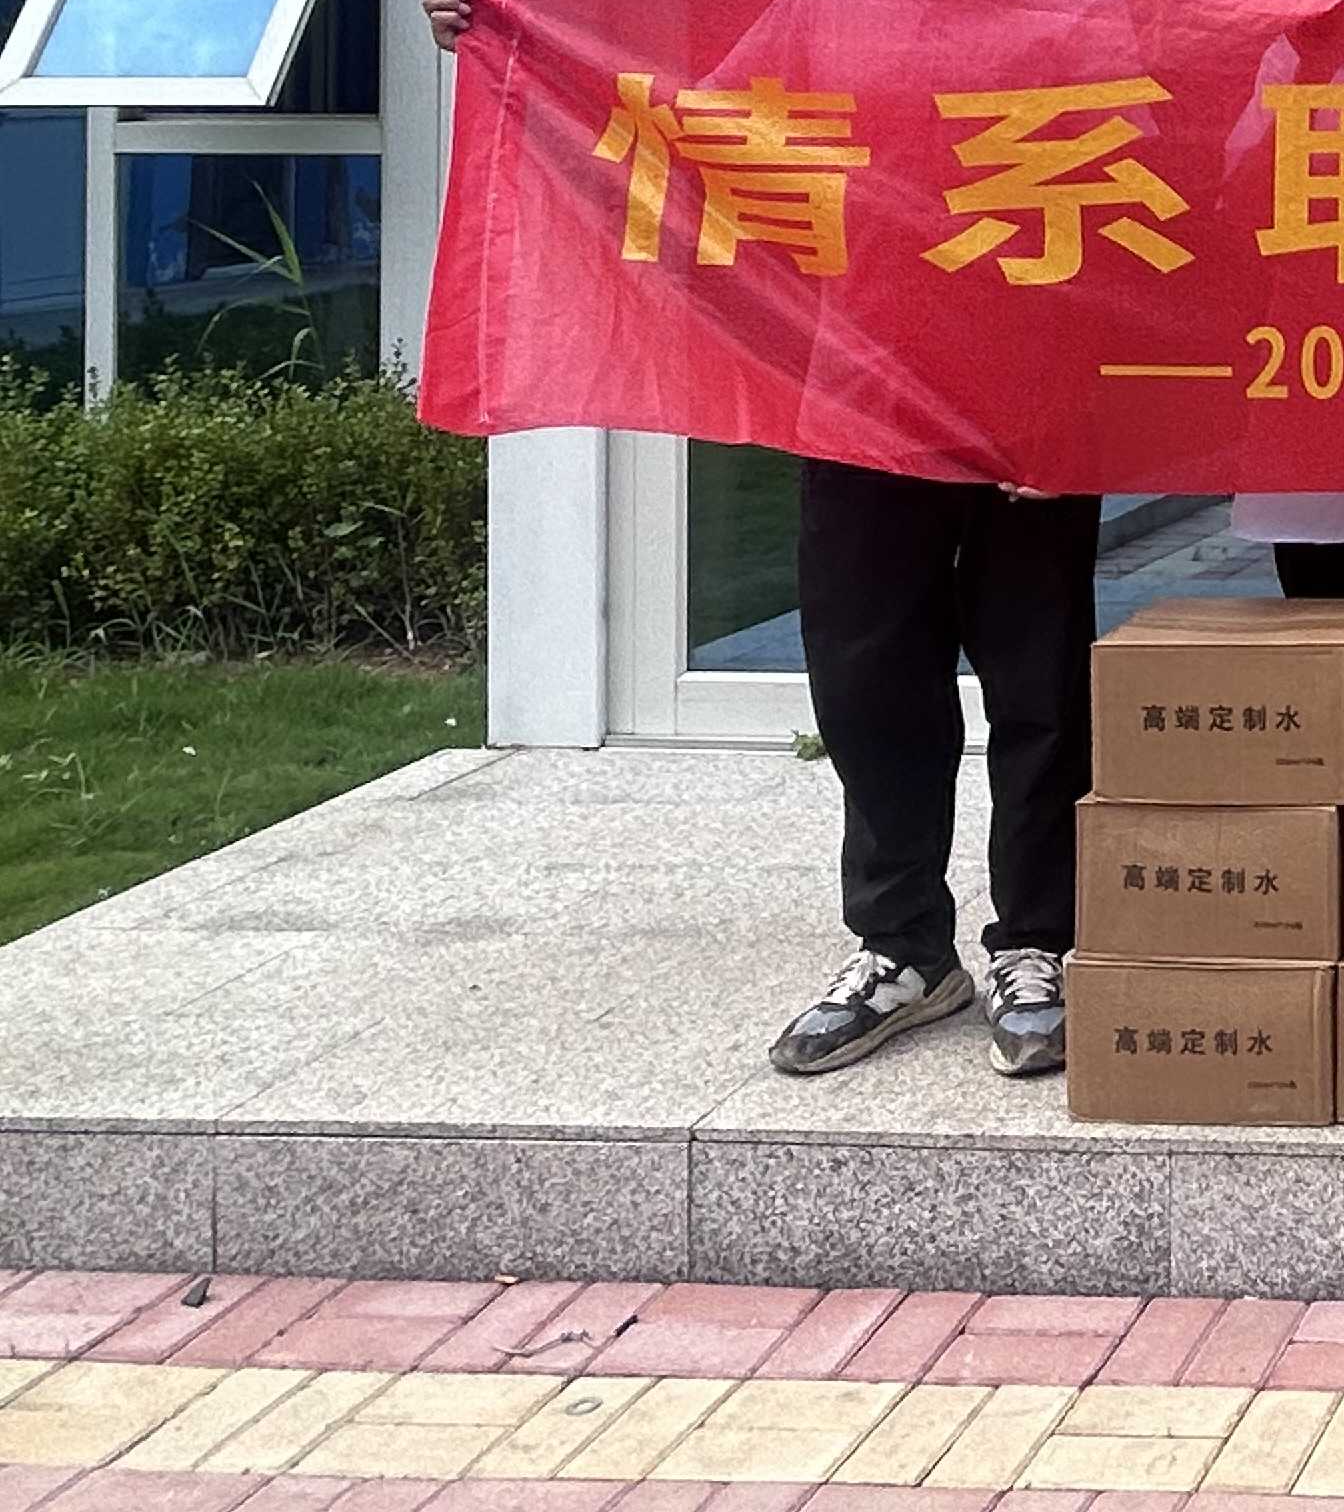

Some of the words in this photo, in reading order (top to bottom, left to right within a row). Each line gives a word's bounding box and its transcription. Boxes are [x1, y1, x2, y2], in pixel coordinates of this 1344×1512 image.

[1141, 703, 1302, 733] 高端定制水
[1121, 863, 1280, 896] 高端定制水
[1113, 1024, 1273, 1056] 高端定制水
